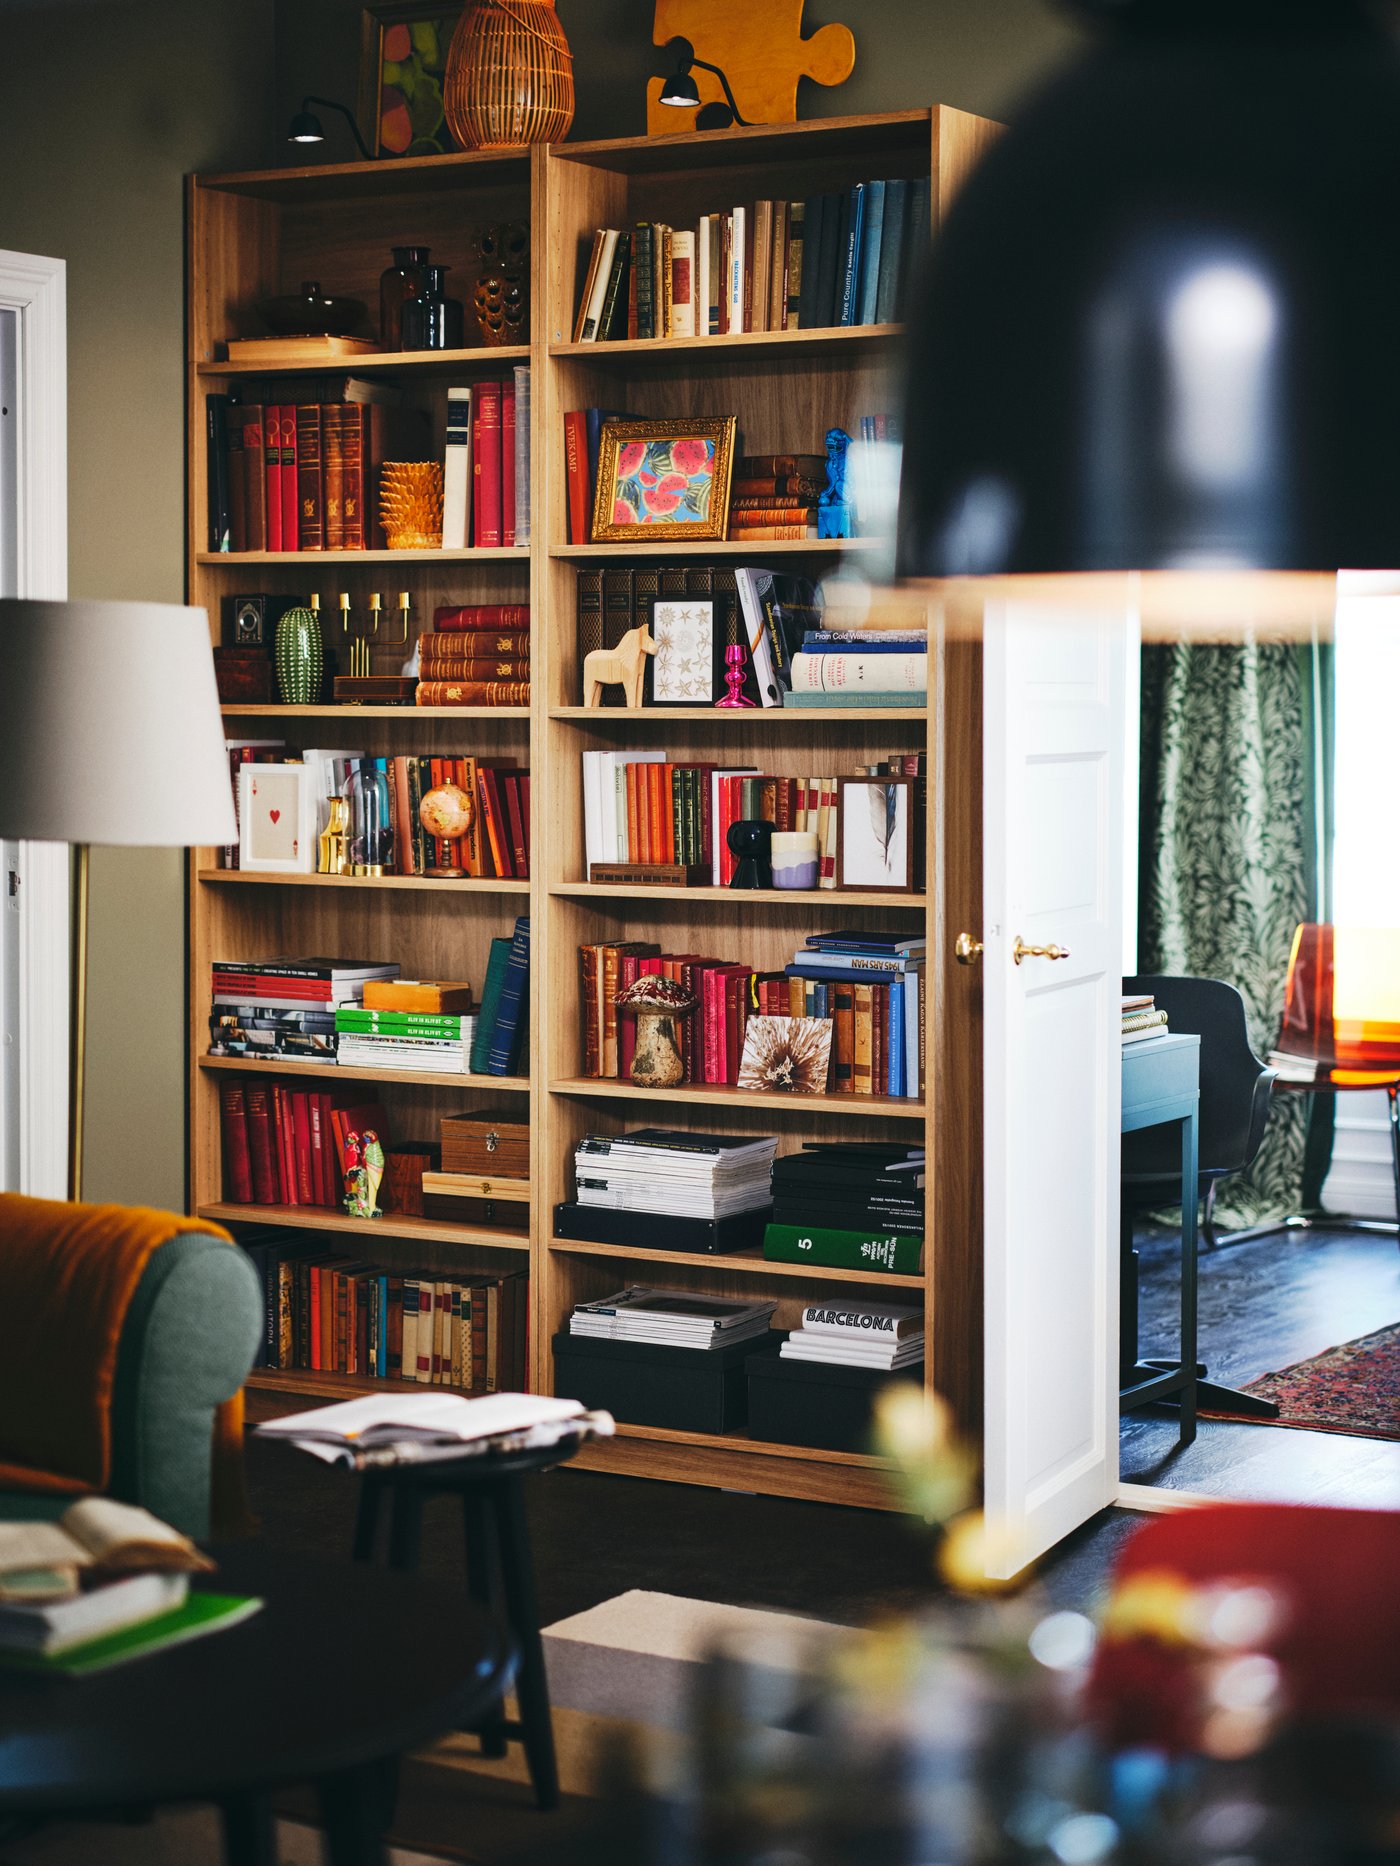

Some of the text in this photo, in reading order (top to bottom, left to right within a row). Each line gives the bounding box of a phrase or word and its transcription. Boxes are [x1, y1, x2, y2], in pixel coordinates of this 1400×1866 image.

[844, 270, 852, 300] Country
[568, 424, 577, 472] TVEKAMP
[766, 602, 774, 629] Scandinavian
[770, 630, 778, 644] Design
[885, 962, 900, 971] 1945
[798, 1238, 812, 1250] 5
[806, 1308, 894, 1331] BARCELONA
